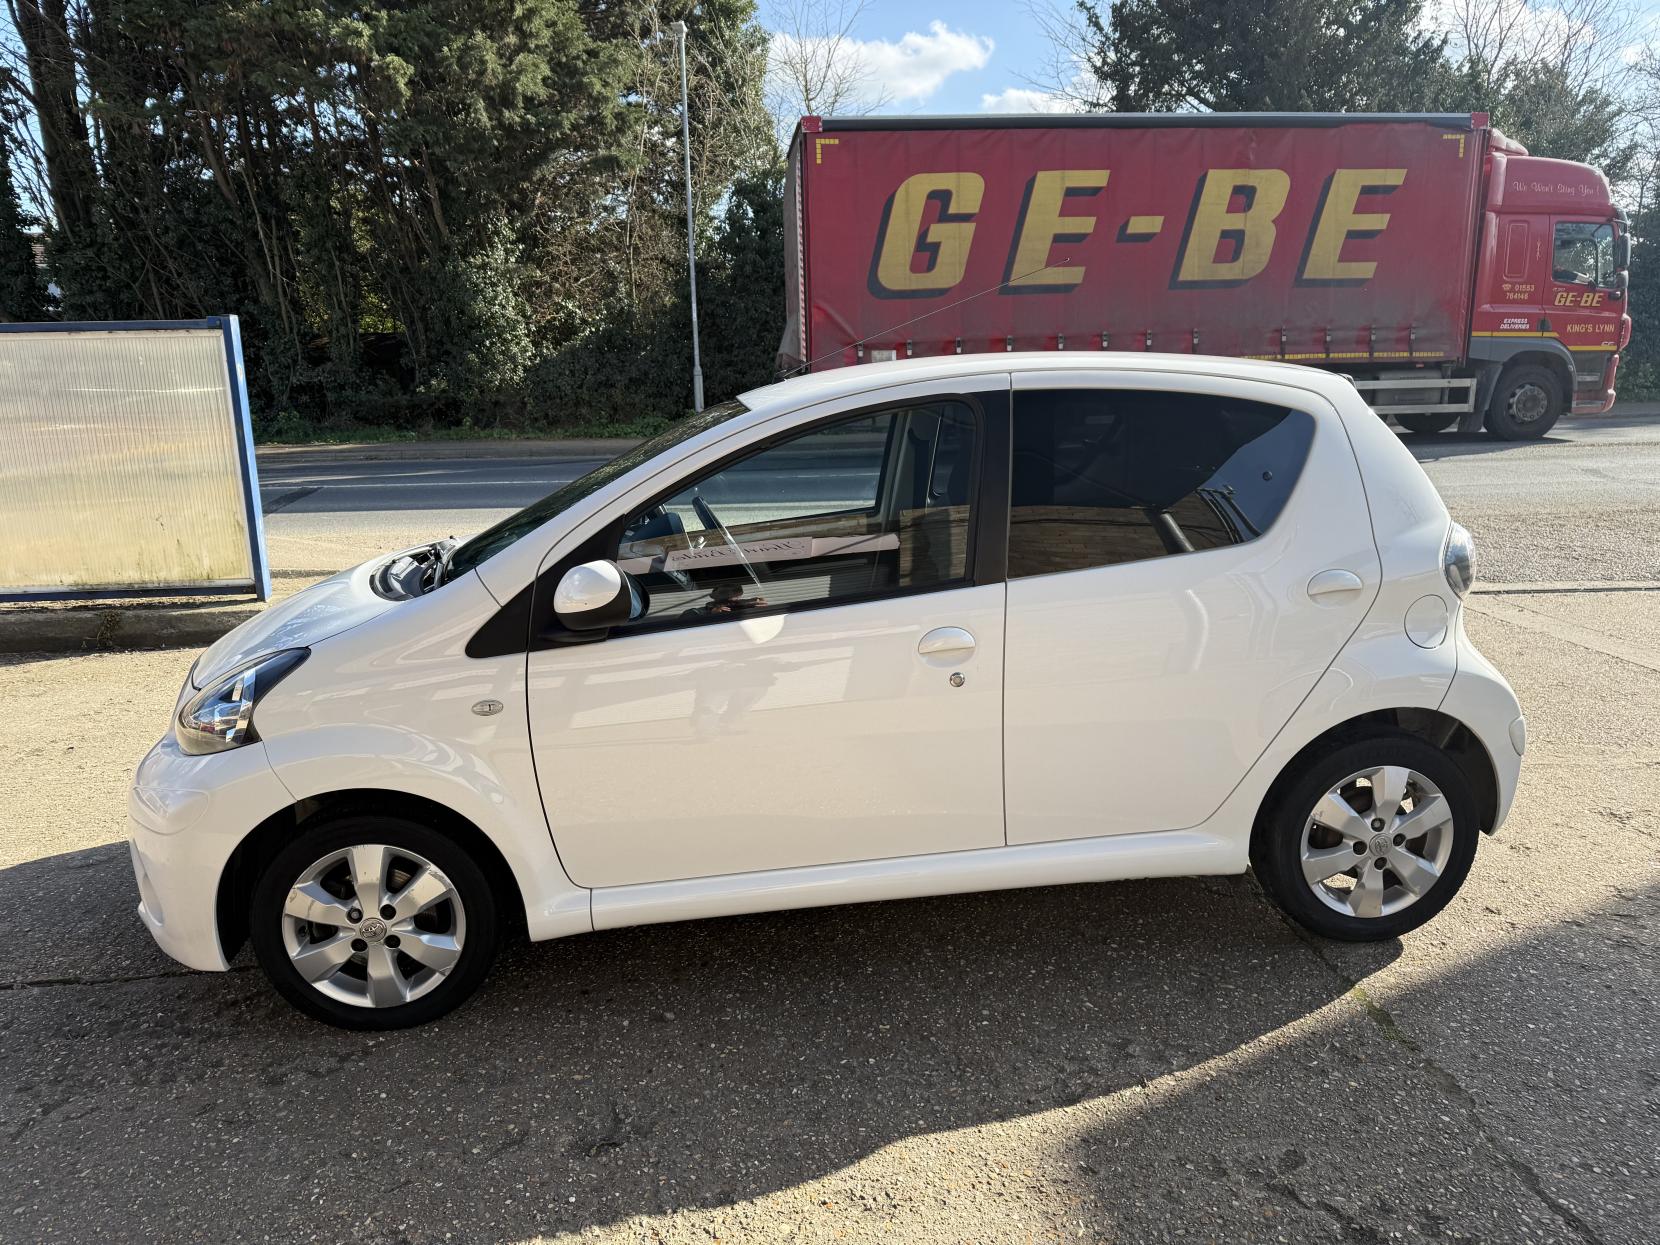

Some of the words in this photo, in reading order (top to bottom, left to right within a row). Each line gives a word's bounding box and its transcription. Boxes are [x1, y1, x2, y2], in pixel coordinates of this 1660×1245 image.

[868, 168, 1408, 300] GE-BE
[1554, 292, 1604, 307] GE-BE
[1567, 324, 1593, 333] KING'S
[1595, 324, 1615, 332] LYNN
